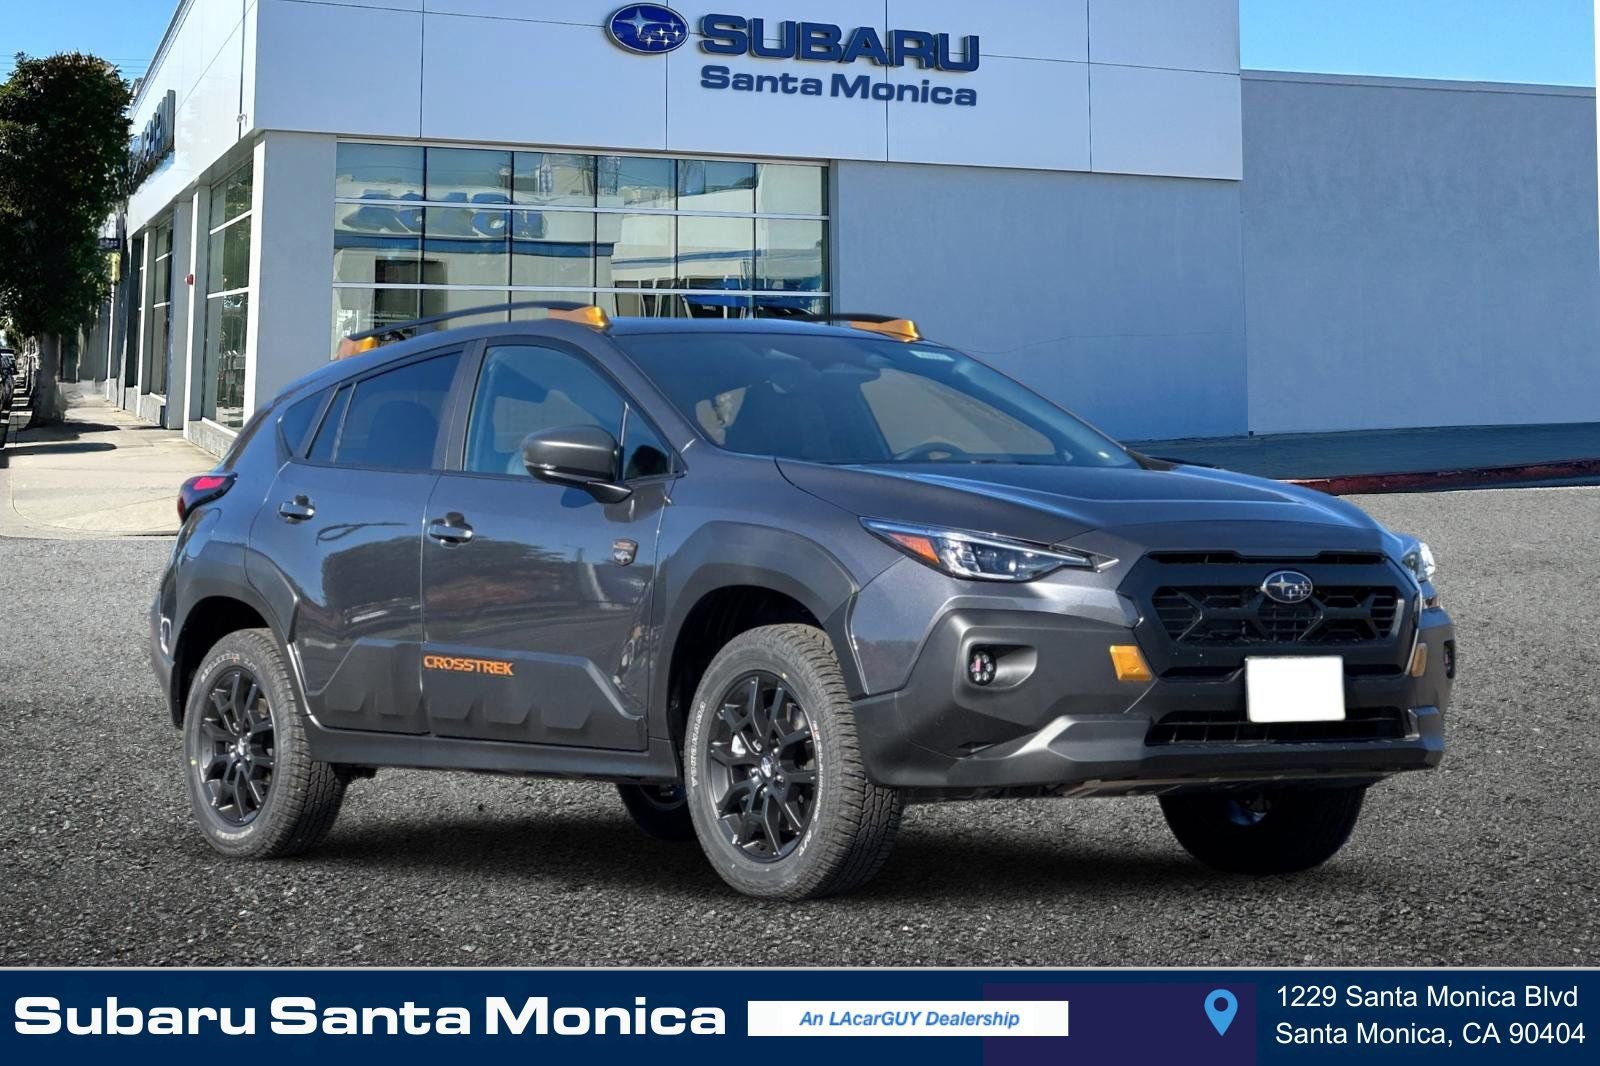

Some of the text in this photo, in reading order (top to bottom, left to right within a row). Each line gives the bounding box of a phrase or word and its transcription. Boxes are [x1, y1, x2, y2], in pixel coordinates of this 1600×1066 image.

[699, 13, 980, 73] SUBARU
[700, 64, 978, 107] Santa Monica
[423, 655, 514, 676] CROSSTREK
